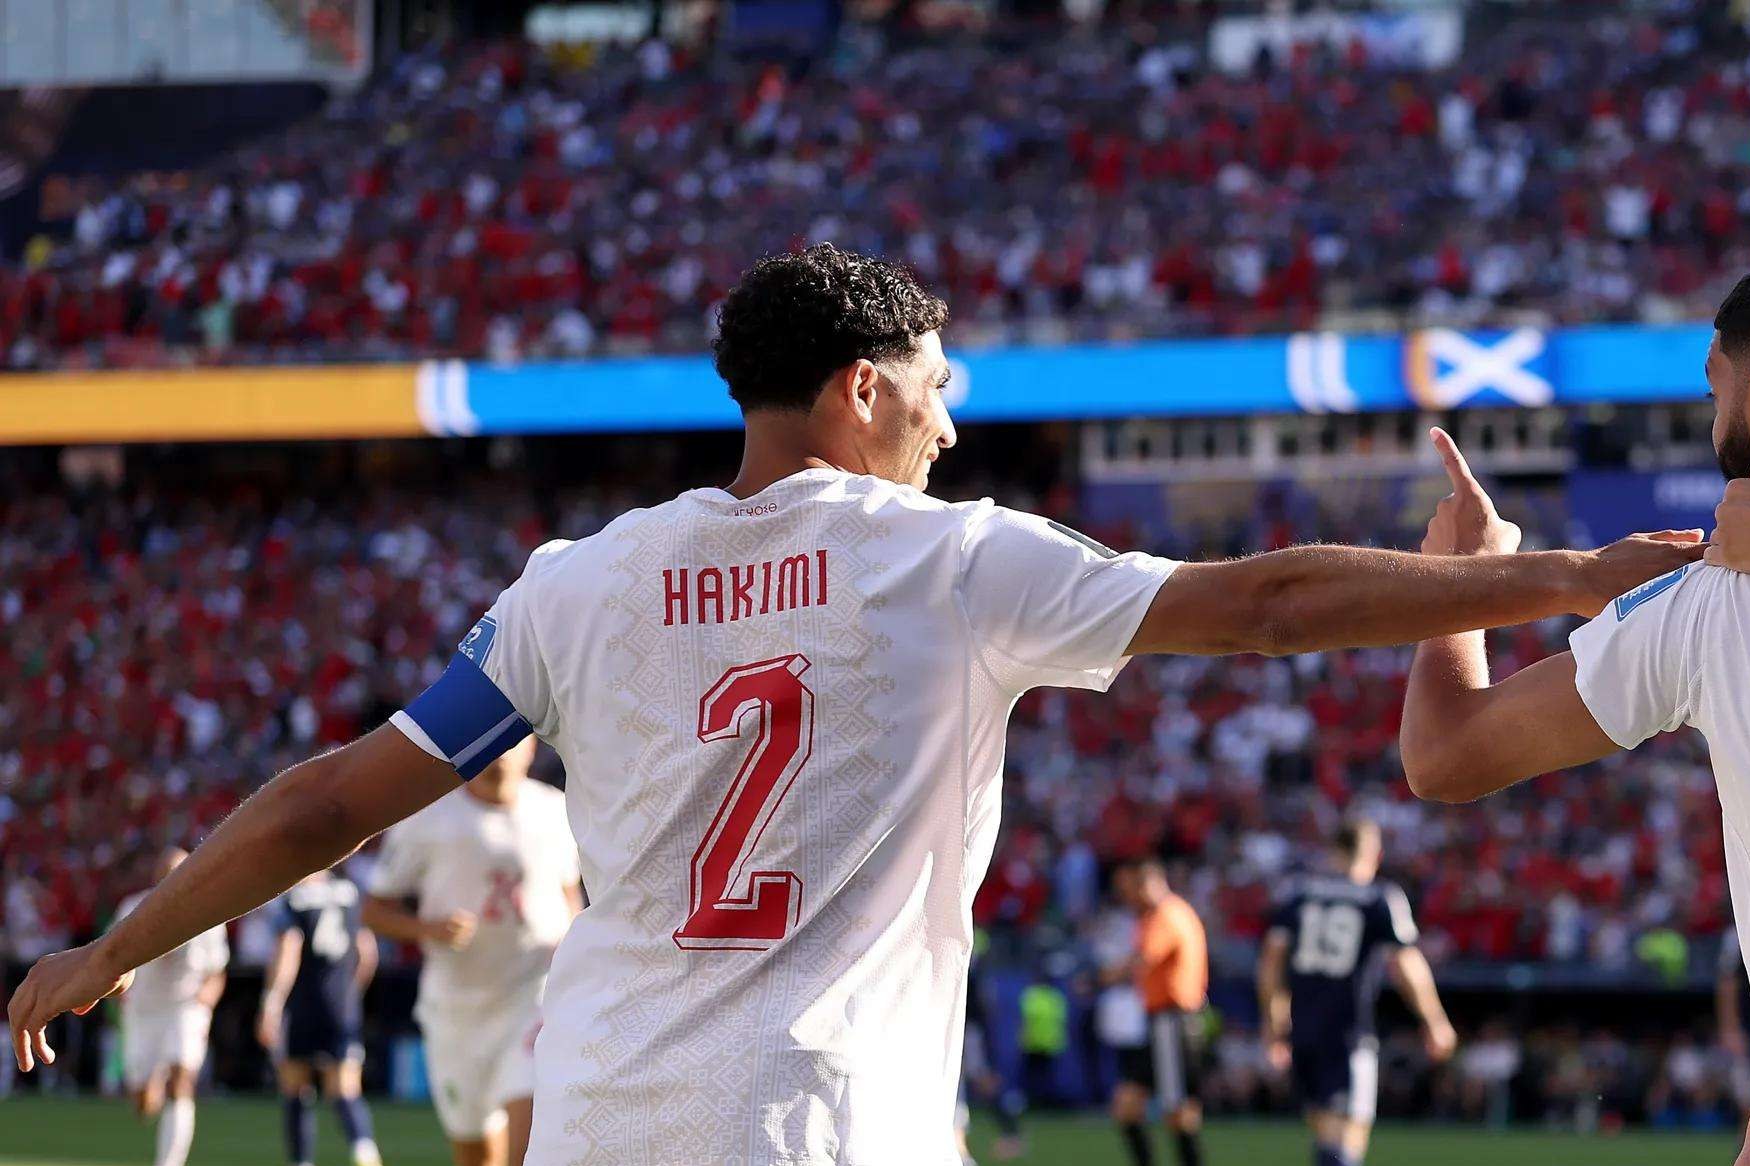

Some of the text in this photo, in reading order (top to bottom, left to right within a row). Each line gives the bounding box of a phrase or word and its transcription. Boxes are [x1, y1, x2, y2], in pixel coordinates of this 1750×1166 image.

[662, 549, 828, 627] HAKIMI
[672, 653, 816, 951] 2
[1291, 901, 1366, 977] 19
